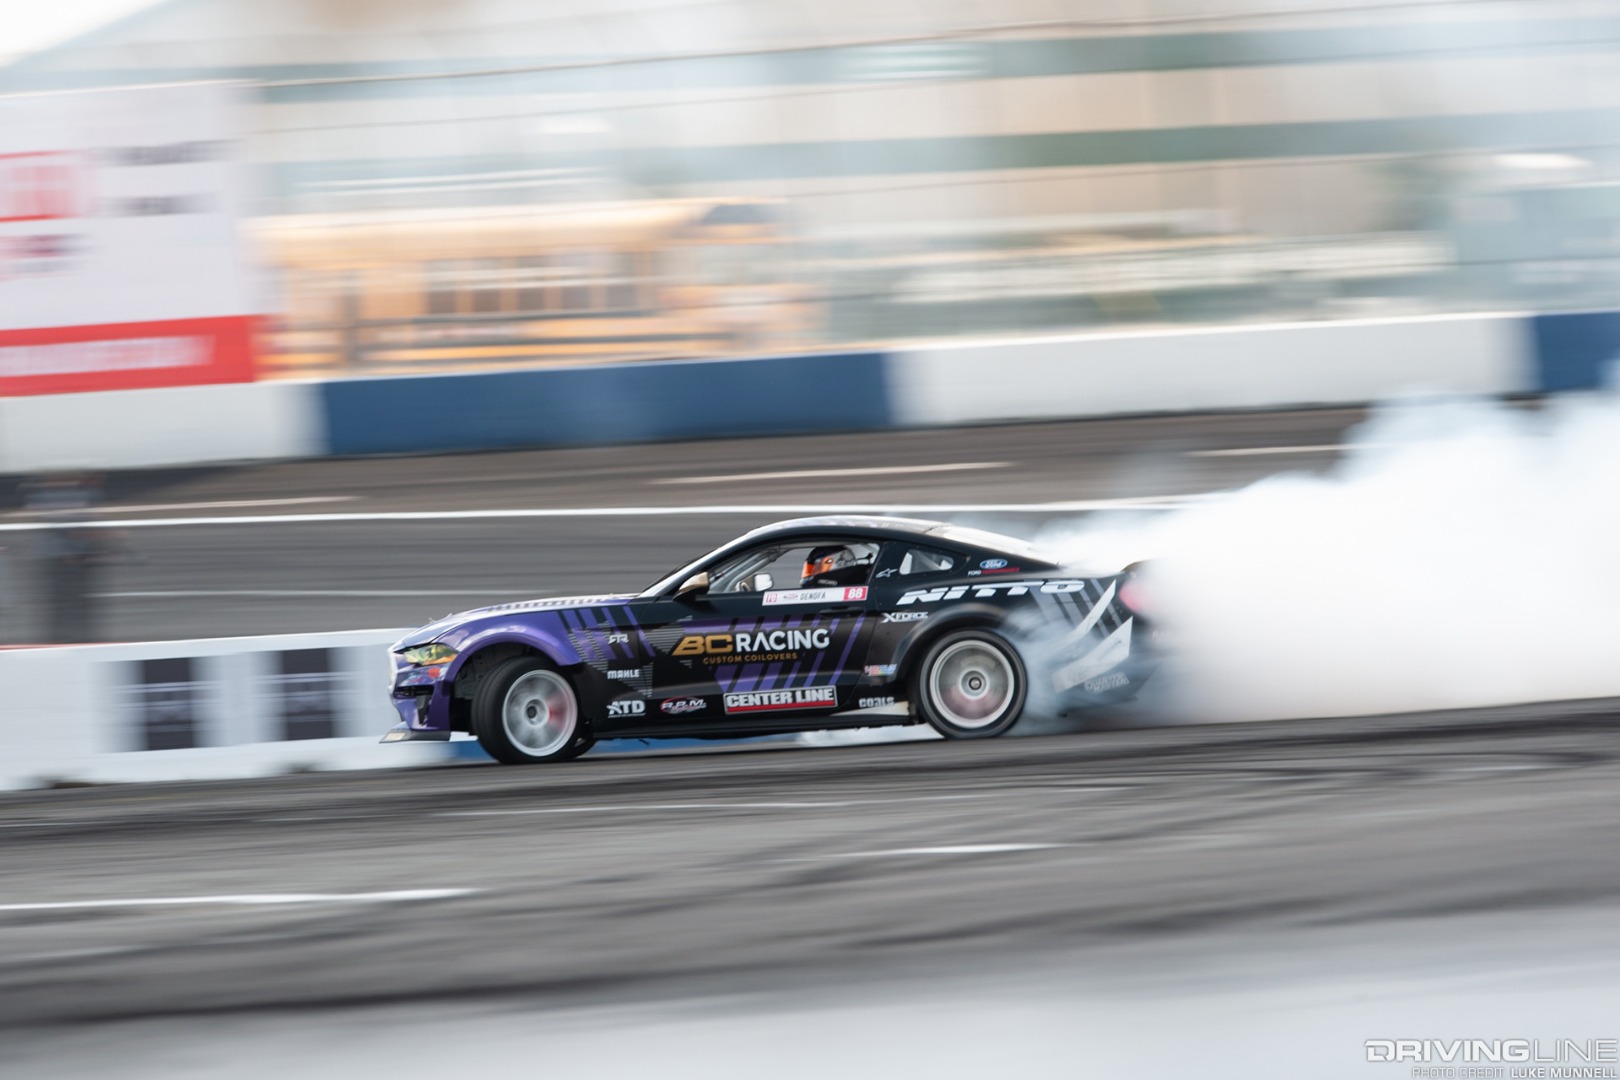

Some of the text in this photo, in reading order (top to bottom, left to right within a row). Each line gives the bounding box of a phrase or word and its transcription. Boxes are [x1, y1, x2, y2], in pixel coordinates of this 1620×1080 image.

[896, 580, 1086, 605] NITTO
[671, 628, 830, 656] BC RACING
[703, 652, 798, 665] CUSTOM COILOVERS
[607, 669, 640, 679] MAHLE
[727, 688, 834, 708] CENTER LINE
[606, 700, 646, 715] ATD
